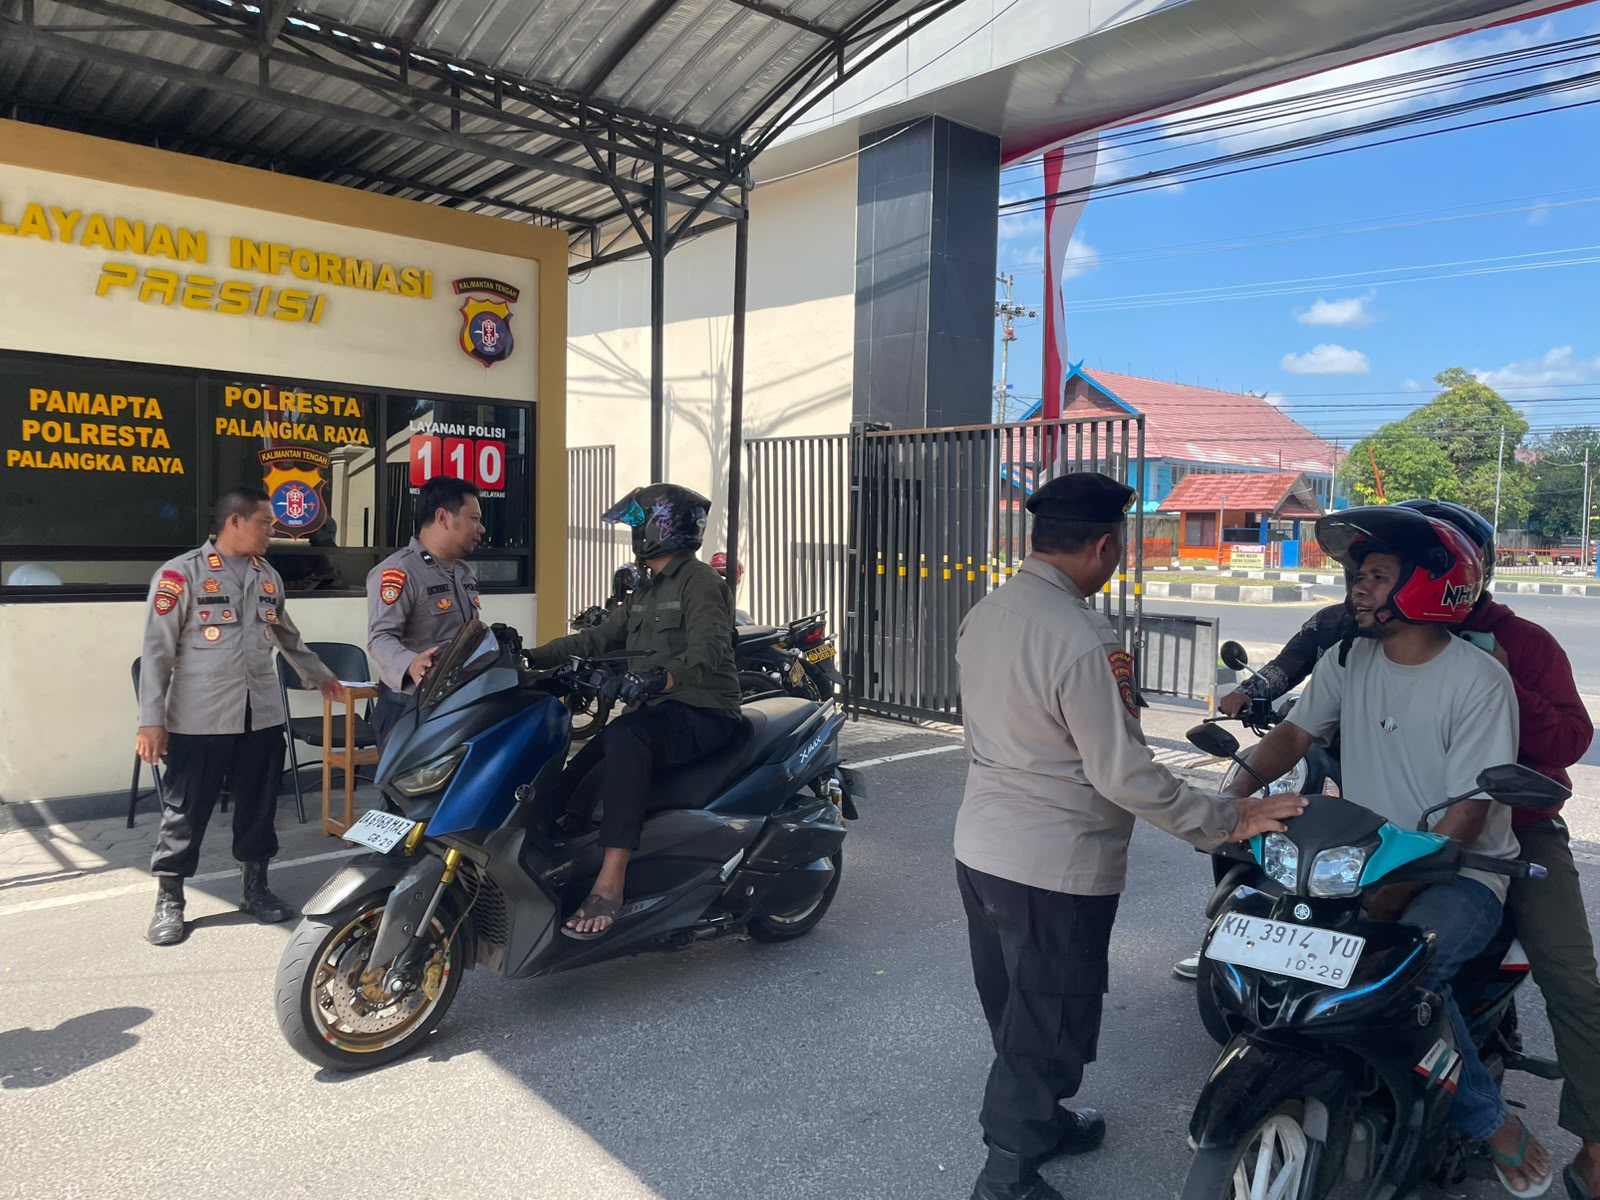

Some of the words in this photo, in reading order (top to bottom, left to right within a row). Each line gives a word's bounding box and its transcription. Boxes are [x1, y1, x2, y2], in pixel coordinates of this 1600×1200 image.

[230, 236, 433, 300] INFORMASI
[96, 262, 325, 324] PRESISI
[459, 281, 494, 290] KALIMANTAN
[495, 283, 518, 297] TENGAH
[29, 388, 164, 420] PAMAPTA
[225, 386, 362, 418] POLRESTA
[22, 419, 171, 449] POLRESTA
[215, 417, 319, 442] PALANGKA
[324, 425, 370, 445] RAYA
[409, 420, 465, 435] LAYANAN
[468, 425, 506, 439] POLISI
[6, 449, 126, 472] PALANGKA
[132, 455, 185, 475] RAYA
[262, 450, 302, 461] KALIMANTAN
[303, 451, 328, 465] TENGAH
[1259, 923, 1315, 949] 3914
[1329, 935, 1359, 958] YU
